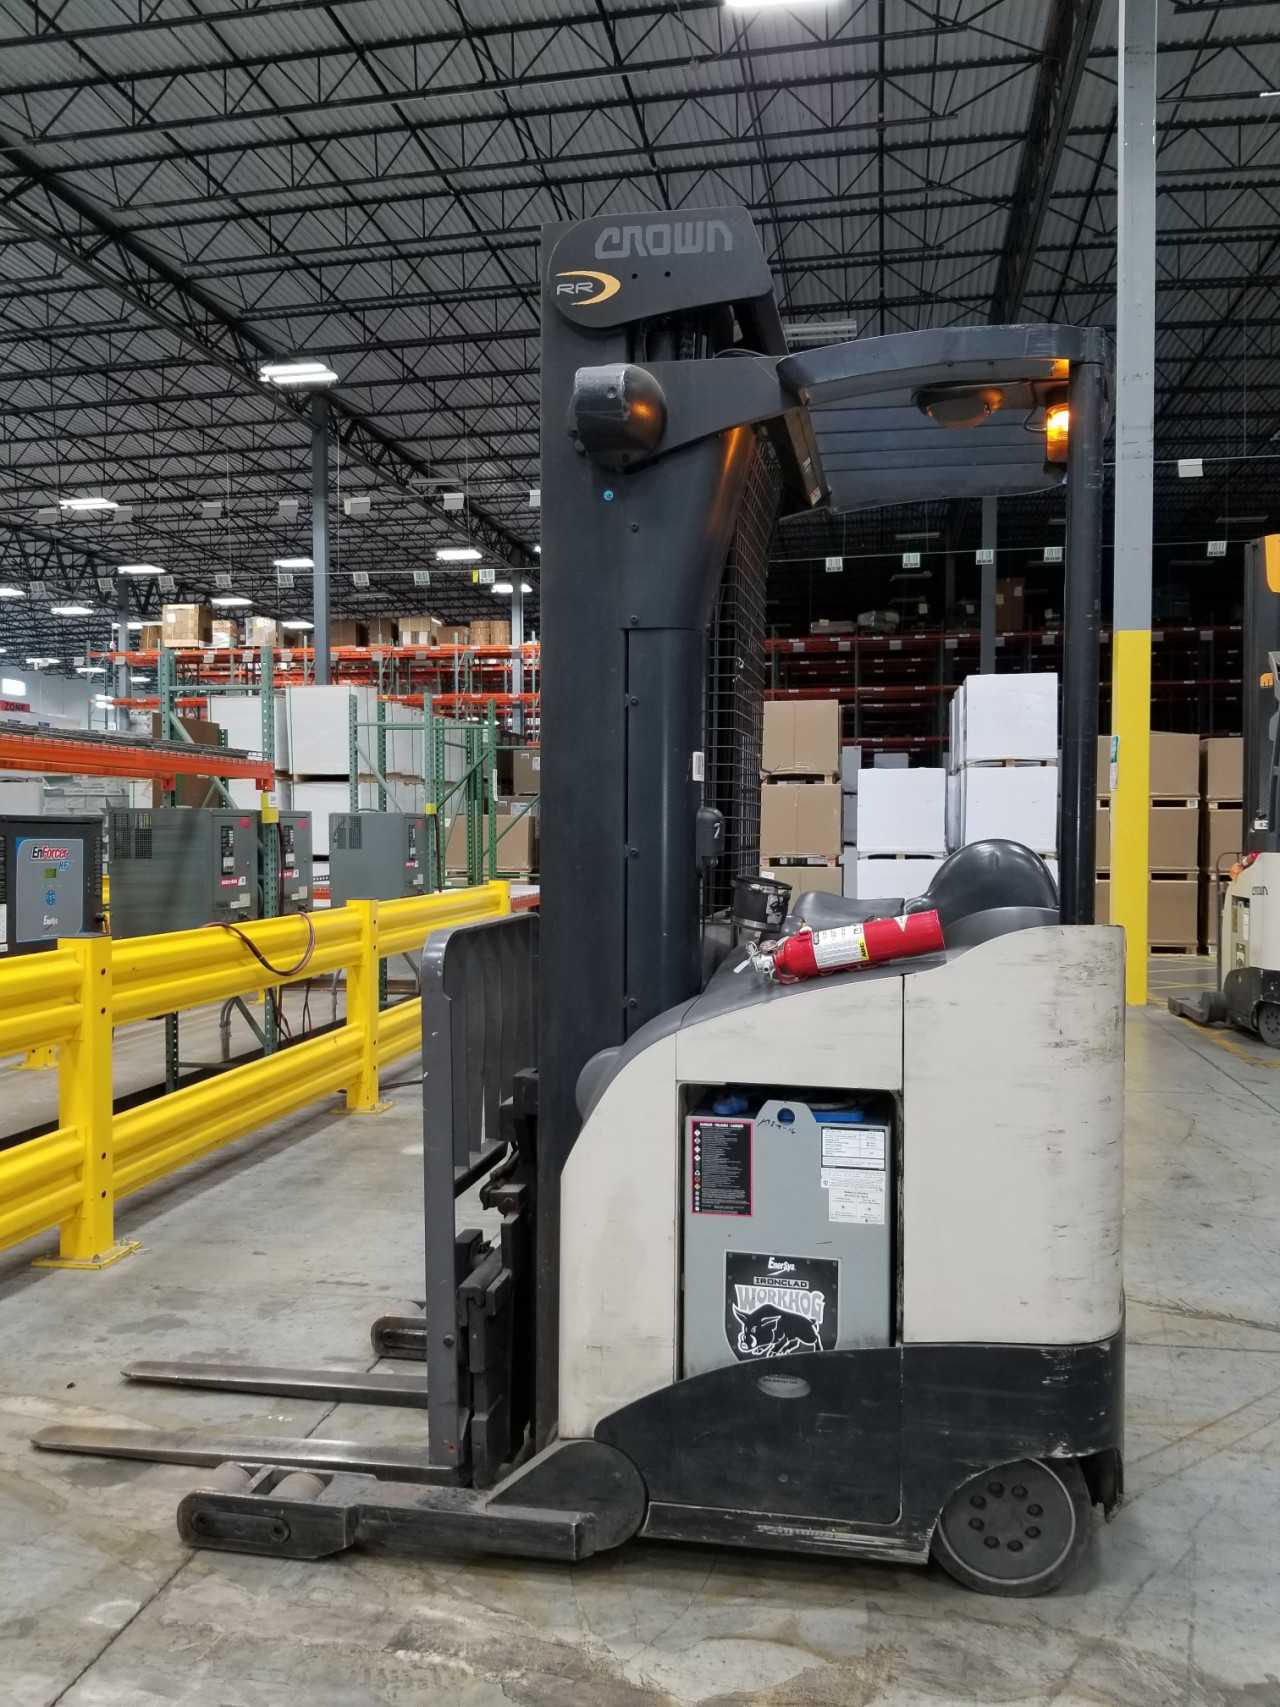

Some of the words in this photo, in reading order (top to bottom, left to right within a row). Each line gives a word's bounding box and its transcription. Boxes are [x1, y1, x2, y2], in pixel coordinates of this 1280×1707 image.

[594, 220, 733, 260] CROWN
[556, 281, 595, 296] RR
[767, 1256, 796, 1273] EnerSys
[755, 1277, 808, 1288] IRONCLAD
[735, 1284, 825, 1324] WORKHOG
